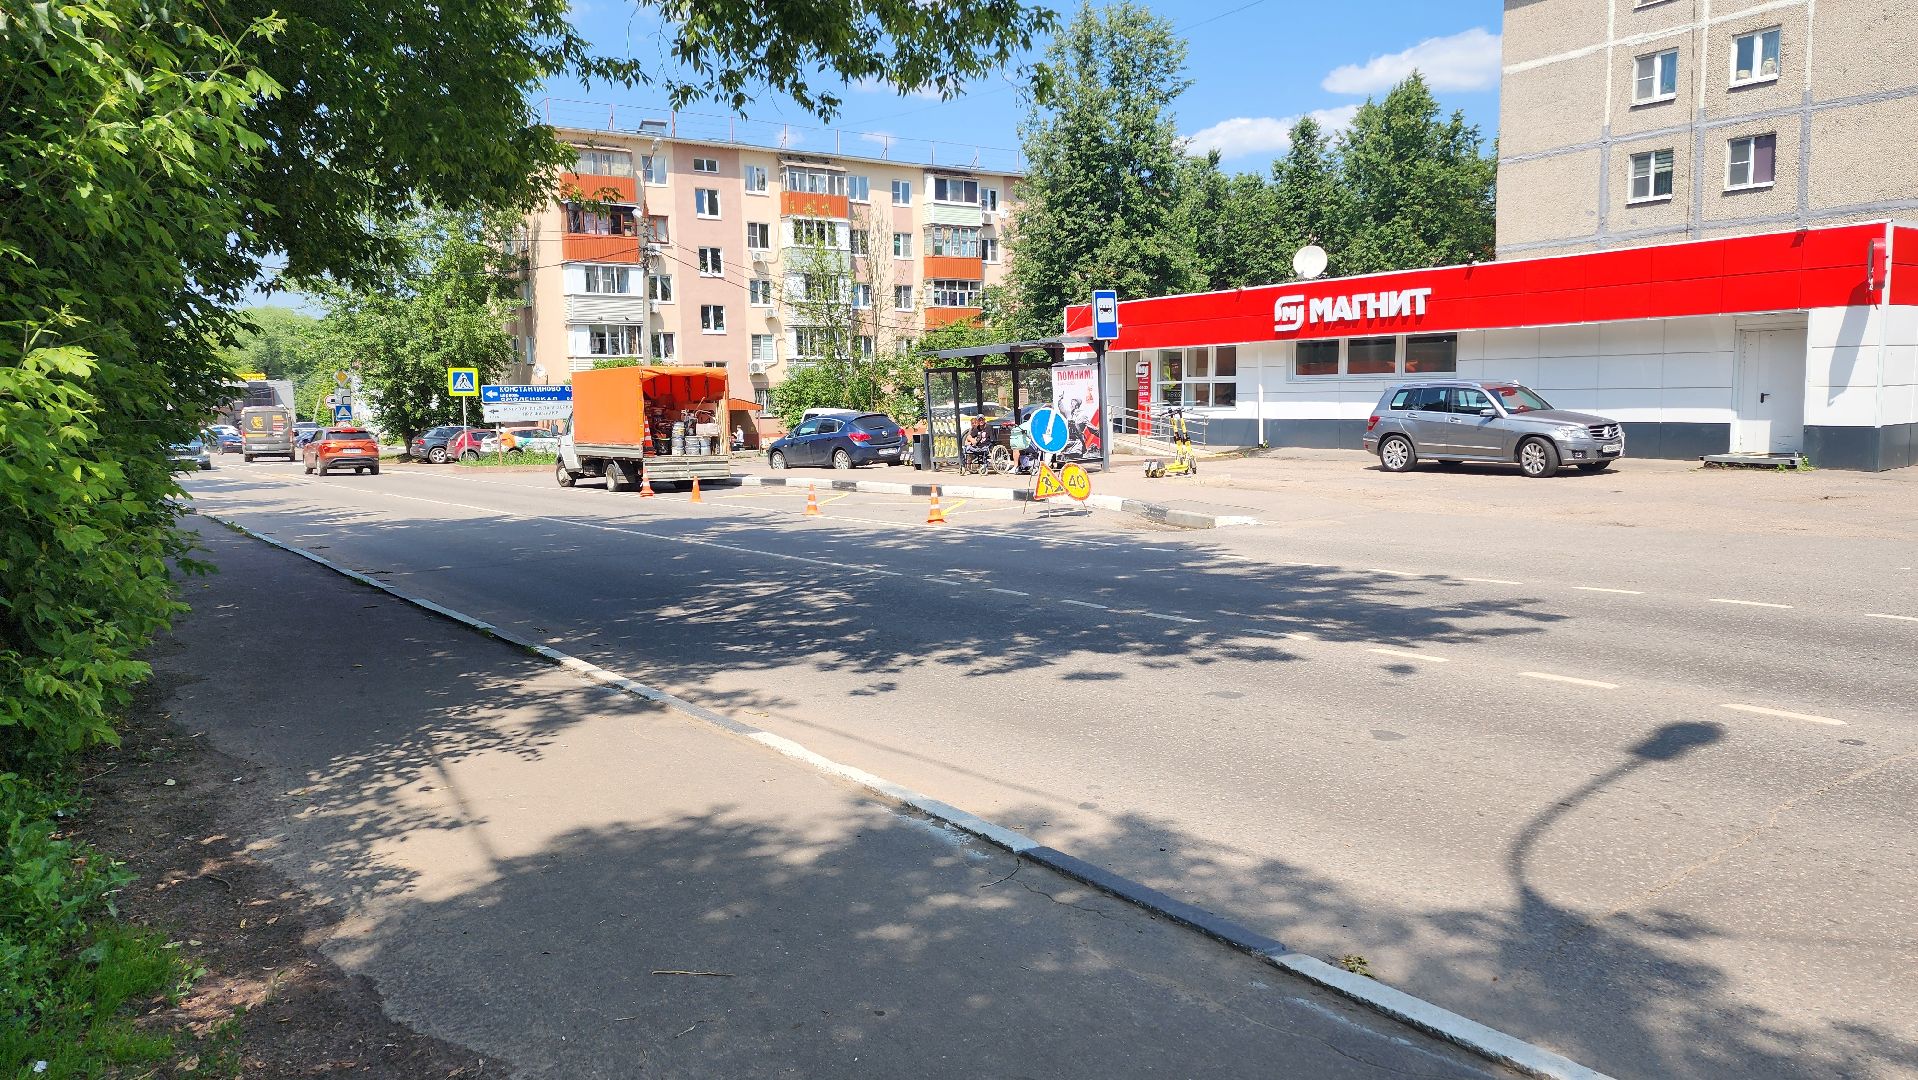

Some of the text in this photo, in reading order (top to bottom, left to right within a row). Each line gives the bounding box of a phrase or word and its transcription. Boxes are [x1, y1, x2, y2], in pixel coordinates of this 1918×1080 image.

[1309, 287, 1432, 324] МАГНИТ
[1057, 369, 1094, 381] ПОМНИМ!
[1068, 474, 1086, 489] 40
